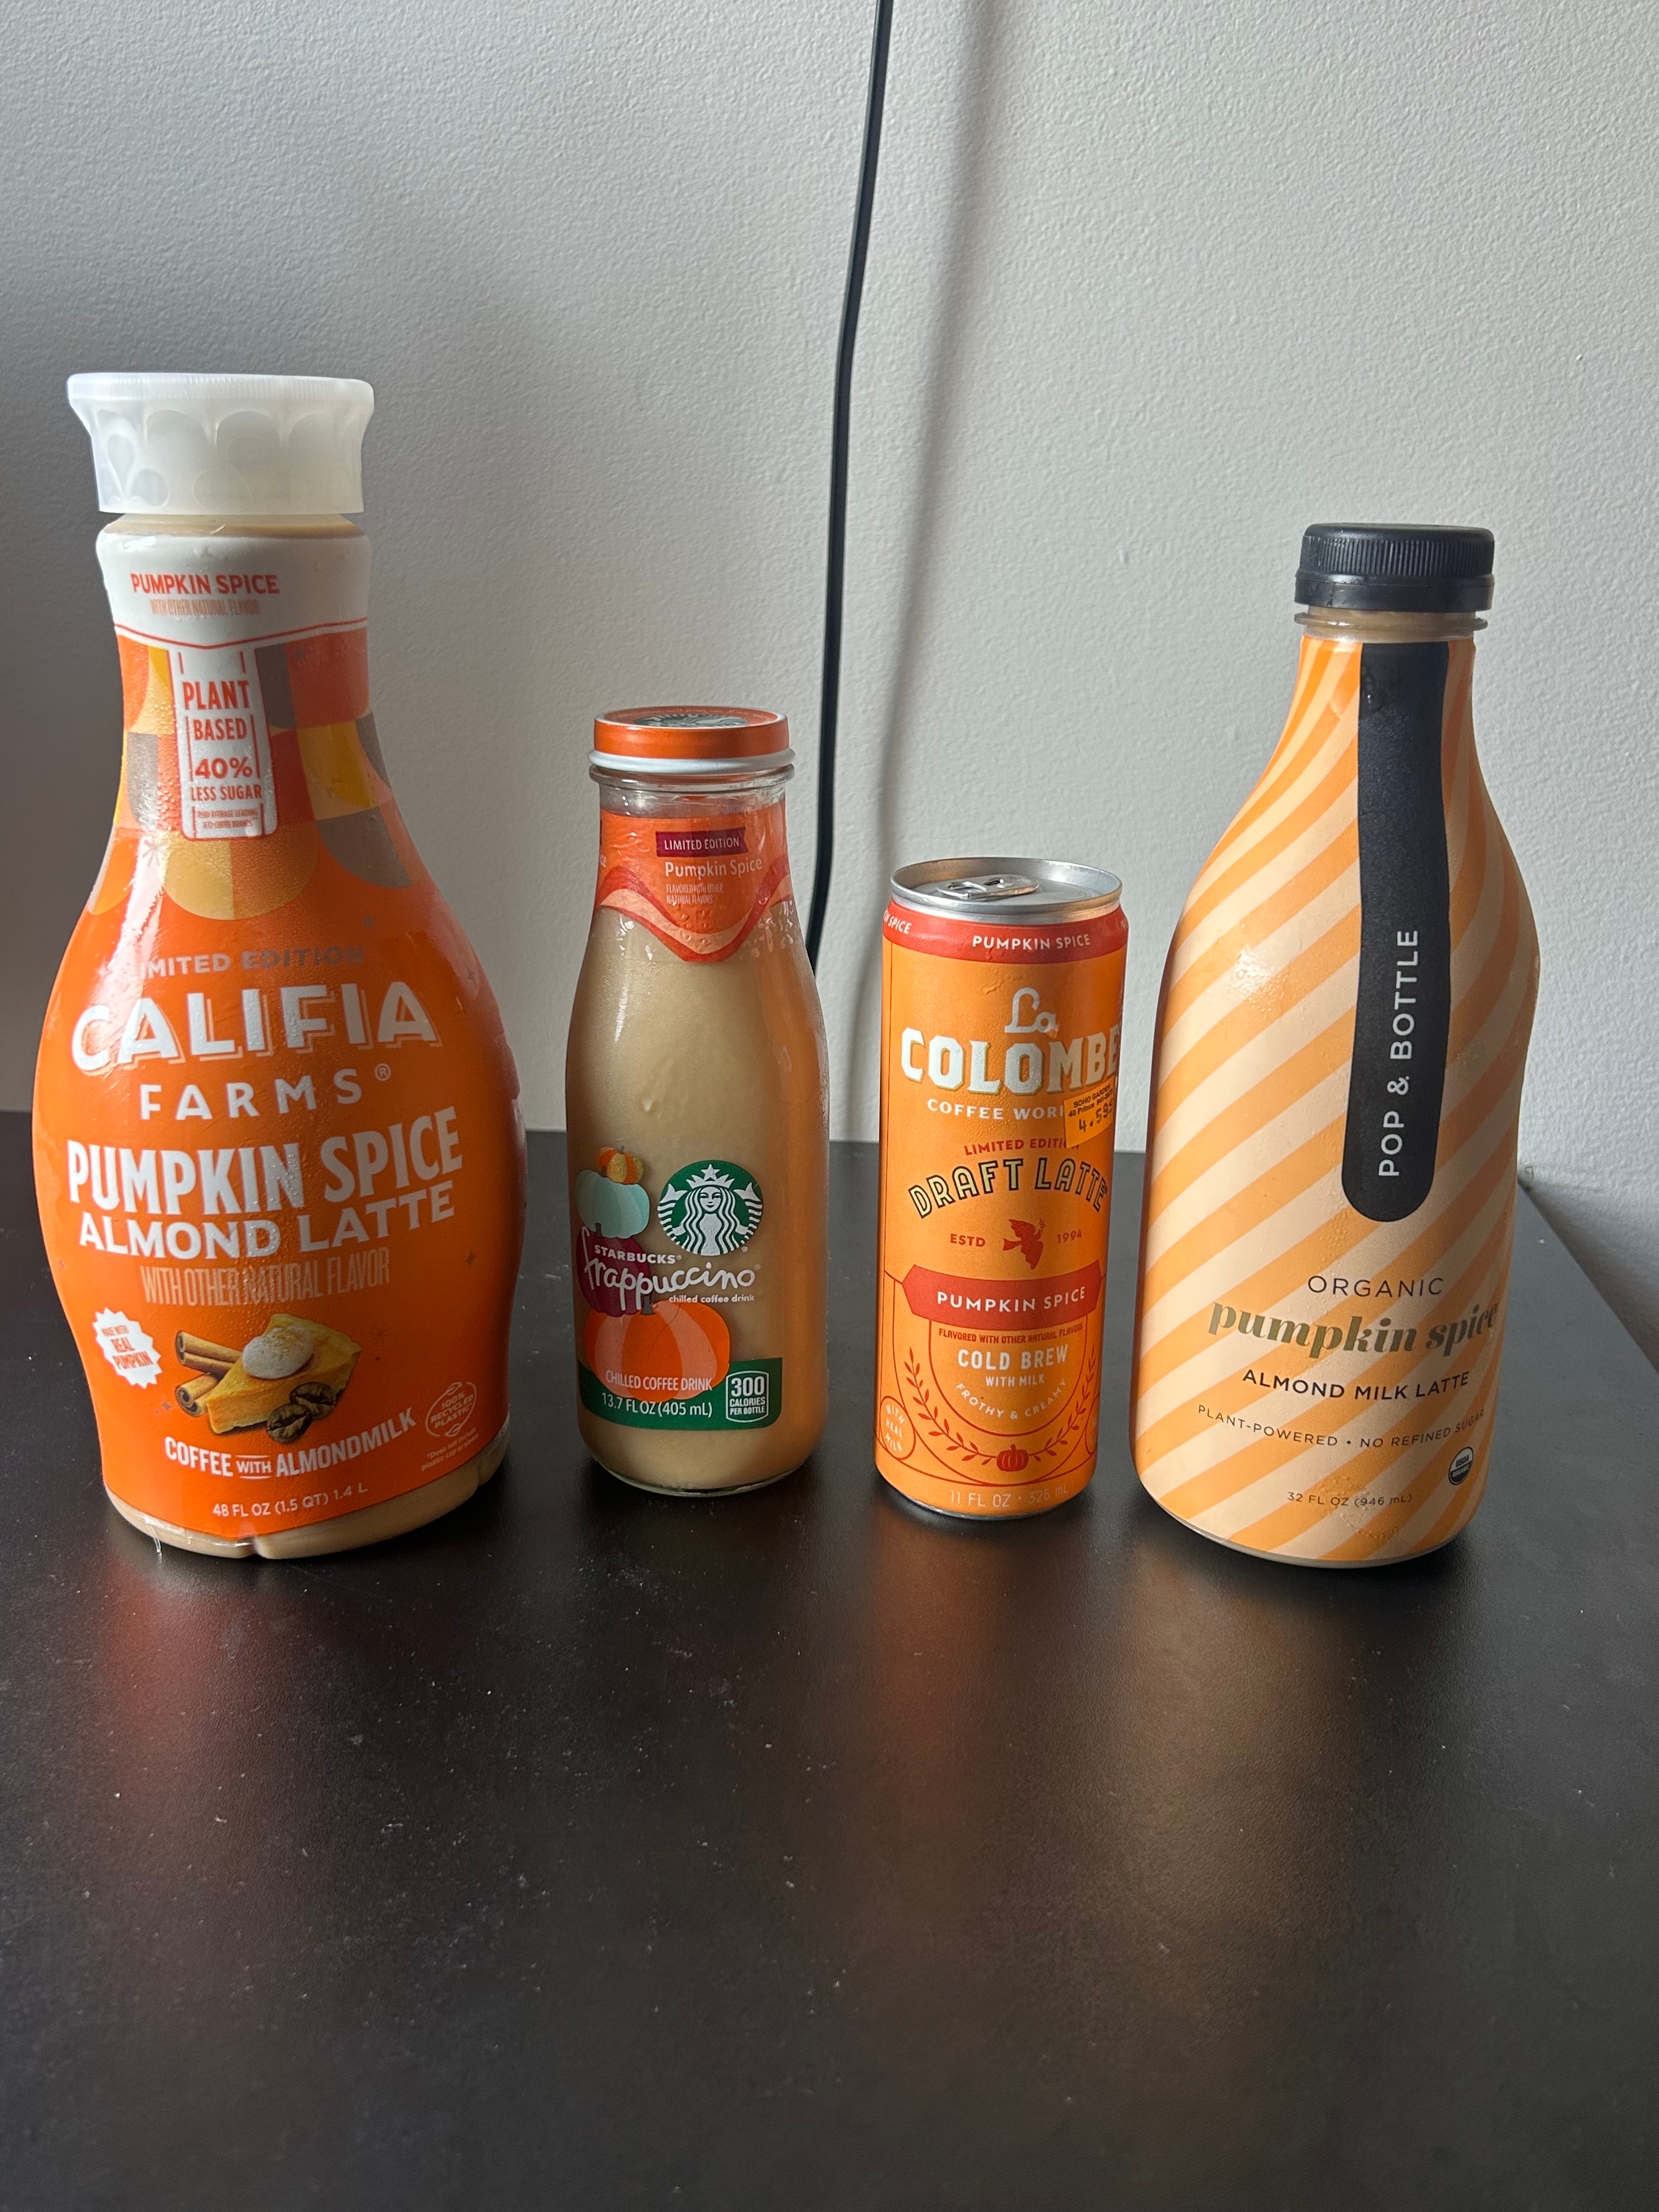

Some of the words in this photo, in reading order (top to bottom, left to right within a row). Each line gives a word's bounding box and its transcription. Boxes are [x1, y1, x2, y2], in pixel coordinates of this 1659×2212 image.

[131, 573, 212, 594] PUMPKIN
[216, 574, 280, 594] SPICE
[182, 680, 250, 710] PLANT
[193, 718, 247, 741] BASED
[195, 757, 253, 779] 40%
[191, 786, 217, 802] LESS
[221, 784, 262, 800] SUGAR
[664, 839, 702, 850] LIMITED
[704, 837, 740, 849] EDITION
[665, 860, 726, 880] Pumpkin
[730, 857, 763, 877] Spice
[666, 884, 693, 893] FLAVORED
[707, 883, 724, 893] OTHER
[667, 895, 691, 904] NATURAL
[692, 894, 713, 904] FLAVORS
[888, 915, 912, 934] SPICE
[972, 935, 1051, 950] PUMPKIN
[1056, 933, 1091, 950] SPICE
[136, 953, 231, 980] IMITED
[242, 946, 364, 970] EDITION
[1390, 930, 1419, 1060] BOTTLE
[1004, 987, 1059, 1034] La
[72, 981, 442, 1076] CALIFIA
[901, 1024, 1120, 1095] COLOMBE
[1386, 1076, 1409, 1096] &
[927, 1099, 1004, 1120] COFFEE
[1074, 1096, 1091, 1108] SOHO
[964, 1138, 1025, 1156] LIMITED
[1378, 1110, 1405, 1176] POP
[67, 1139, 305, 1216] PUMPKIN
[320, 1105, 464, 1203] SPICE
[909, 1158, 1024, 1219] DRAFT
[1035, 1156, 1107, 1213] LATTE
[78, 1211, 281, 1260] ALMOND
[300, 1180, 456, 1253] LATTE
[950, 1233, 986, 1247] ESTD
[1057, 1228, 1082, 1244] 1994
[140, 1265, 185, 1306] WITH
[187, 1268, 240, 1308] OTHER
[241, 1262, 323, 1306] NATURAL
[328, 1247, 391, 1292] FLAVOR
[1307, 1276, 1444, 1298] ORGANIC
[700, 1295, 729, 1303] coffee
[731, 1294, 755, 1302] drink
[937, 1291, 1036, 1313] PUMPKIN
[1043, 1286, 1086, 1310] SPICE
[939, 1328, 977, 1342] FLAVORED
[979, 1334, 999, 1344] WITH
[1001, 1335, 1026, 1344] OTHER
[1028, 1331, 1058, 1344] NATURAL
[1059, 1322, 1084, 1338] FLAVORS
[1208, 1301, 1418, 1359] pumpkin
[1424, 1304, 1498, 1357] spice
[110, 1336, 136, 1353] REAL
[112, 1351, 154, 1370] PUMPKIN
[958, 1348, 1010, 1370] COLD
[1021, 1344, 1068, 1370] BREW
[606, 1370, 641, 1389] CHILLED
[642, 1376, 679, 1391] COFFEE
[681, 1378, 713, 1391] DRINK
[731, 1376, 765, 1397] 300
[985, 1375, 1015, 1387] WITH
[1019, 1373, 1045, 1386] MILK
[1242, 1369, 1345, 1399] ALMOND
[1354, 1384, 1408, 1401] MILK
[1415, 1371, 1469, 1398] LATTE
[431, 1394, 473, 1423] RECYCLED
[602, 1392, 623, 1409] 13.7
[626, 1399, 639, 1413] FL
[640, 1401, 656, 1414] OZ
[658, 1401, 686, 1417] (405
[689, 1402, 713, 1418] mL)
[729, 1397, 766, 1408] CALORIES
[730, 1407, 742, 1415] PER
[743, 1406, 765, 1415] BOTTLE
[956, 1382, 1005, 1418] FROTHY
[1010, 1410, 1019, 1420] &
[1025, 1379, 1066, 1417] CREAMY
[885, 1404, 905, 1424] WITH
[886, 1417, 903, 1438] REAL
[1198, 1404, 1339, 1447] PLANT-POWERED
[1360, 1437, 1384, 1448] NO
[1391, 1427, 1451, 1447] REFINED
[1454, 1409, 1485, 1434] SUGAR
[164, 1436, 233, 1477] COFFEE
[236, 1460, 272, 1474] WITH
[276, 1407, 416, 1477] ALMONDMILK
[885, 1432, 903, 1451] MILK
[212, 1503, 229, 1517] 48
[233, 1503, 249, 1517] FL
[251, 1502, 271, 1516] OZ
[275, 1498, 298, 1515] (1.5
[302, 1492, 329, 1508] QT)
[333, 1486, 353, 1500] 1.4
[358, 1482, 368, 1493] L
[950, 1490, 960, 1504] 11
[968, 1492, 985, 1507] FL
[992, 1494, 1011, 1508] OZ
[1055, 1482, 1069, 1497] mL
[1287, 1491, 1304, 1503] 32
[1308, 1494, 1324, 1505] FL
[1330, 1496, 1349, 1506] OZ
[1354, 1496, 1385, 1508] (946
[1390, 1493, 1413, 1504] mL)
